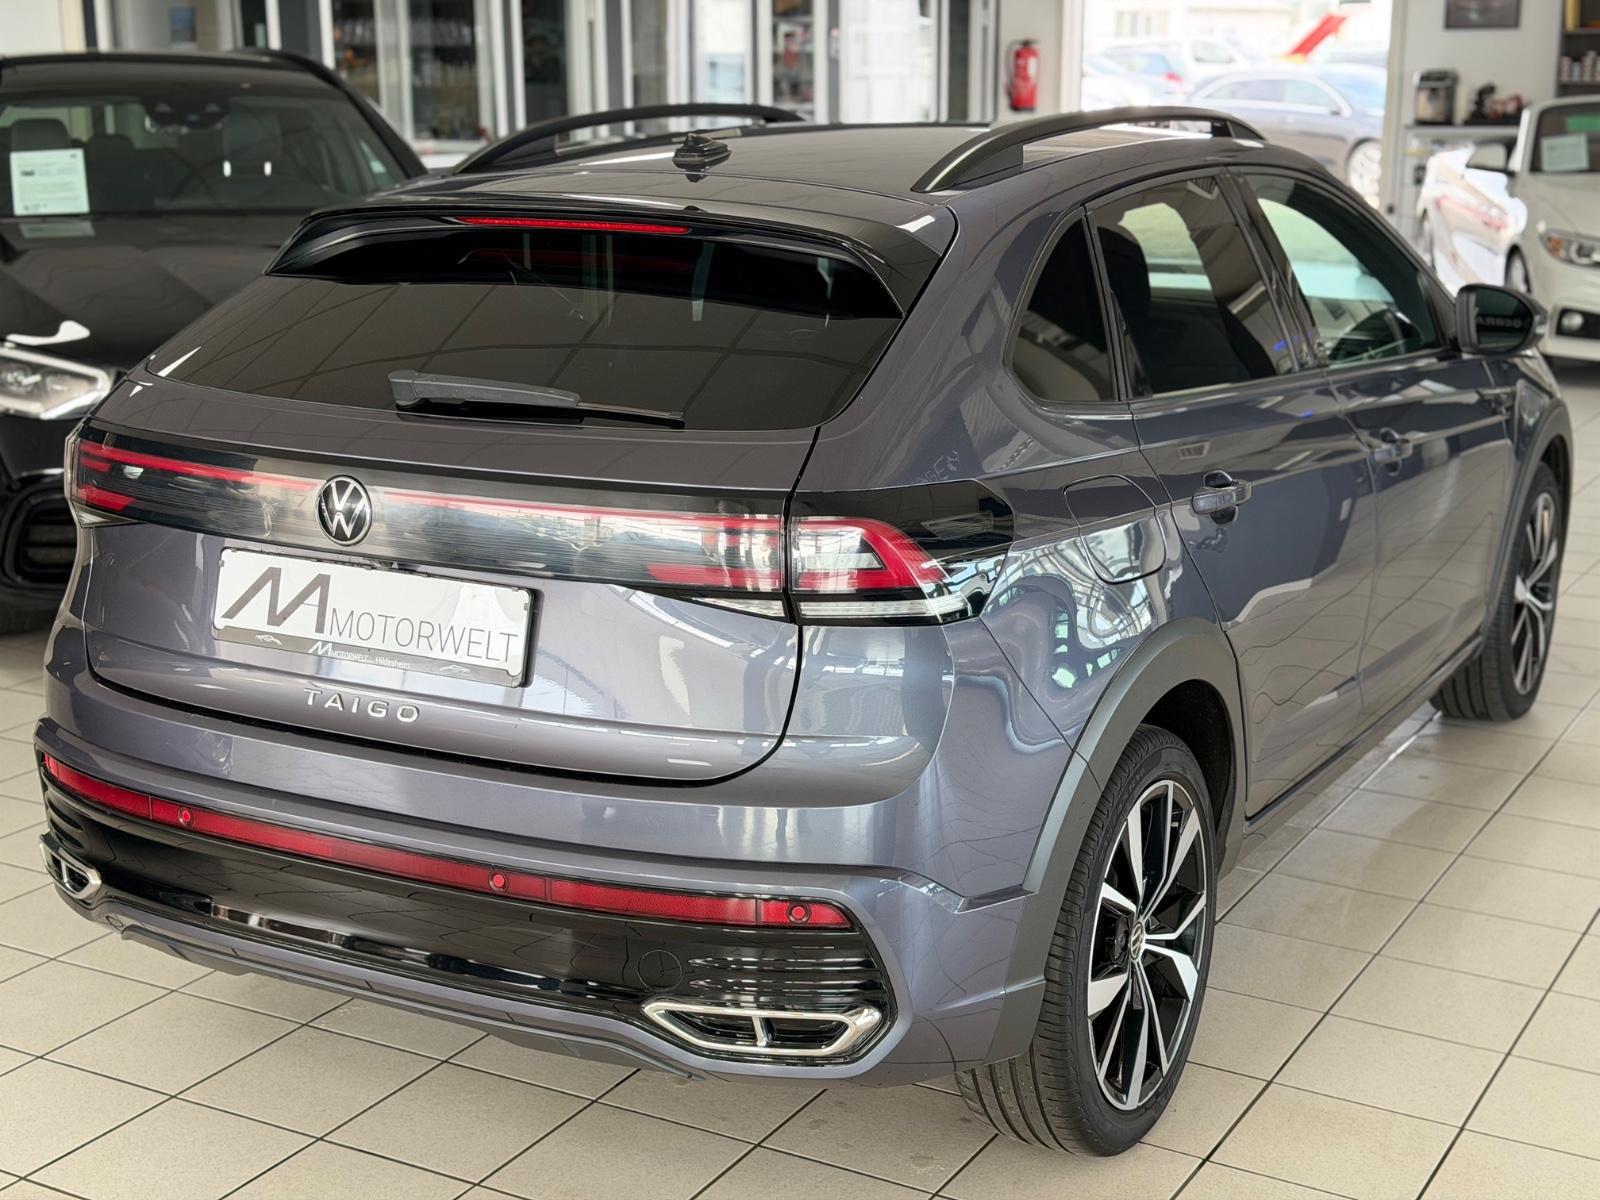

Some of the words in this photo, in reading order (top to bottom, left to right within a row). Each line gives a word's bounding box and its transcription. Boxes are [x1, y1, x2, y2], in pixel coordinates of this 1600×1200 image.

[319, 476, 371, 545] VW
[329, 607, 519, 663] MOTORWELT
[304, 688, 419, 723] TAIGO
